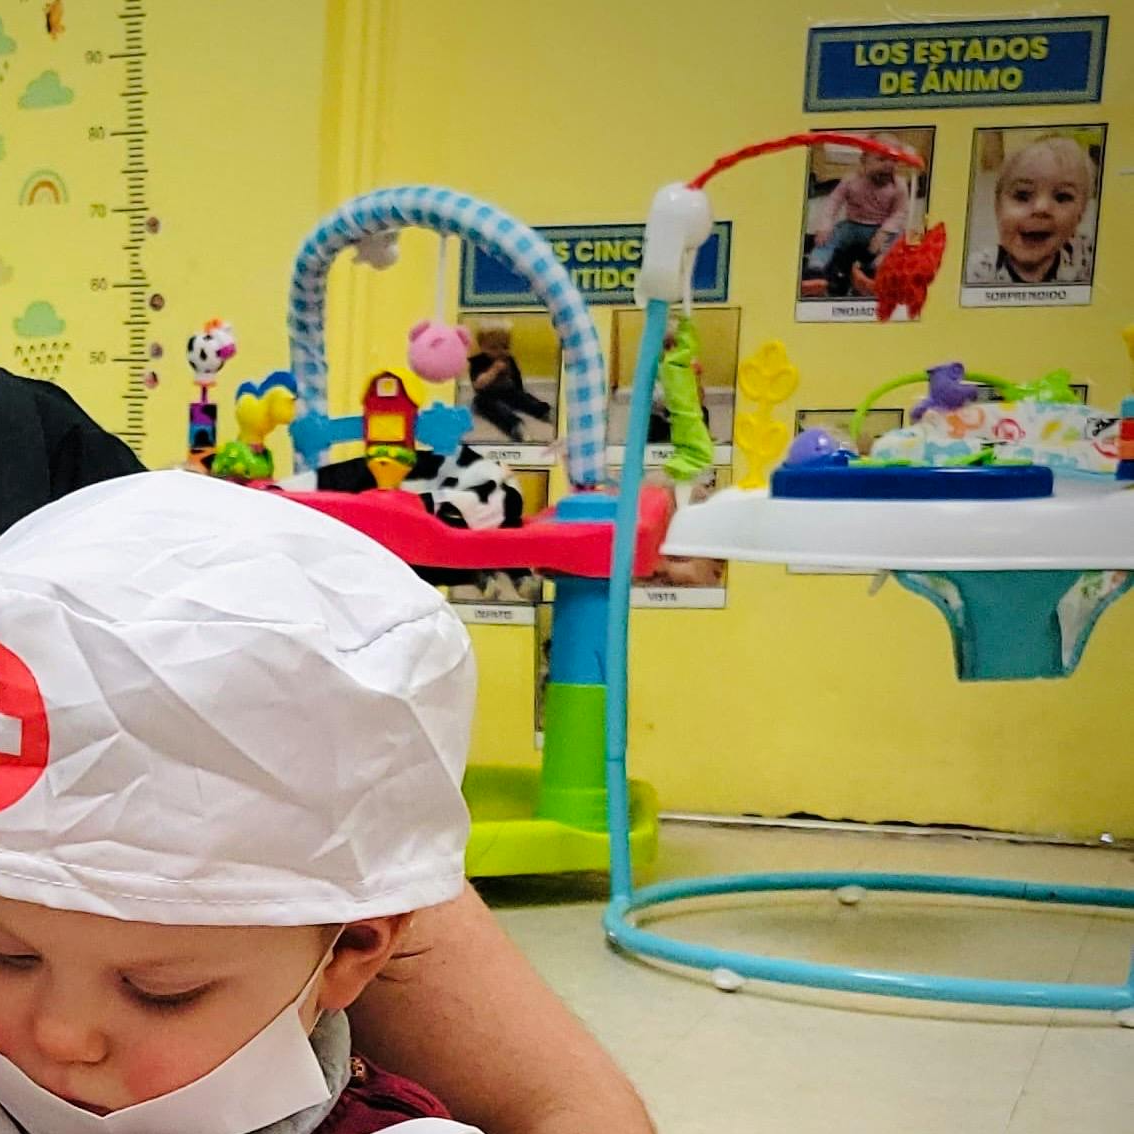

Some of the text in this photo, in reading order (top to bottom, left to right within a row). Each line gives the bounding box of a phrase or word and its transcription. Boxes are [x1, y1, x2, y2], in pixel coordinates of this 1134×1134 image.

[854, 36, 1049, 67] LOS ESTADOS
[878, 63, 1024, 96] DE ÁNIMO
[89, 203, 107, 218] 70
[574, 239, 643, 263] CINC
[89, 351, 107, 365] 50
